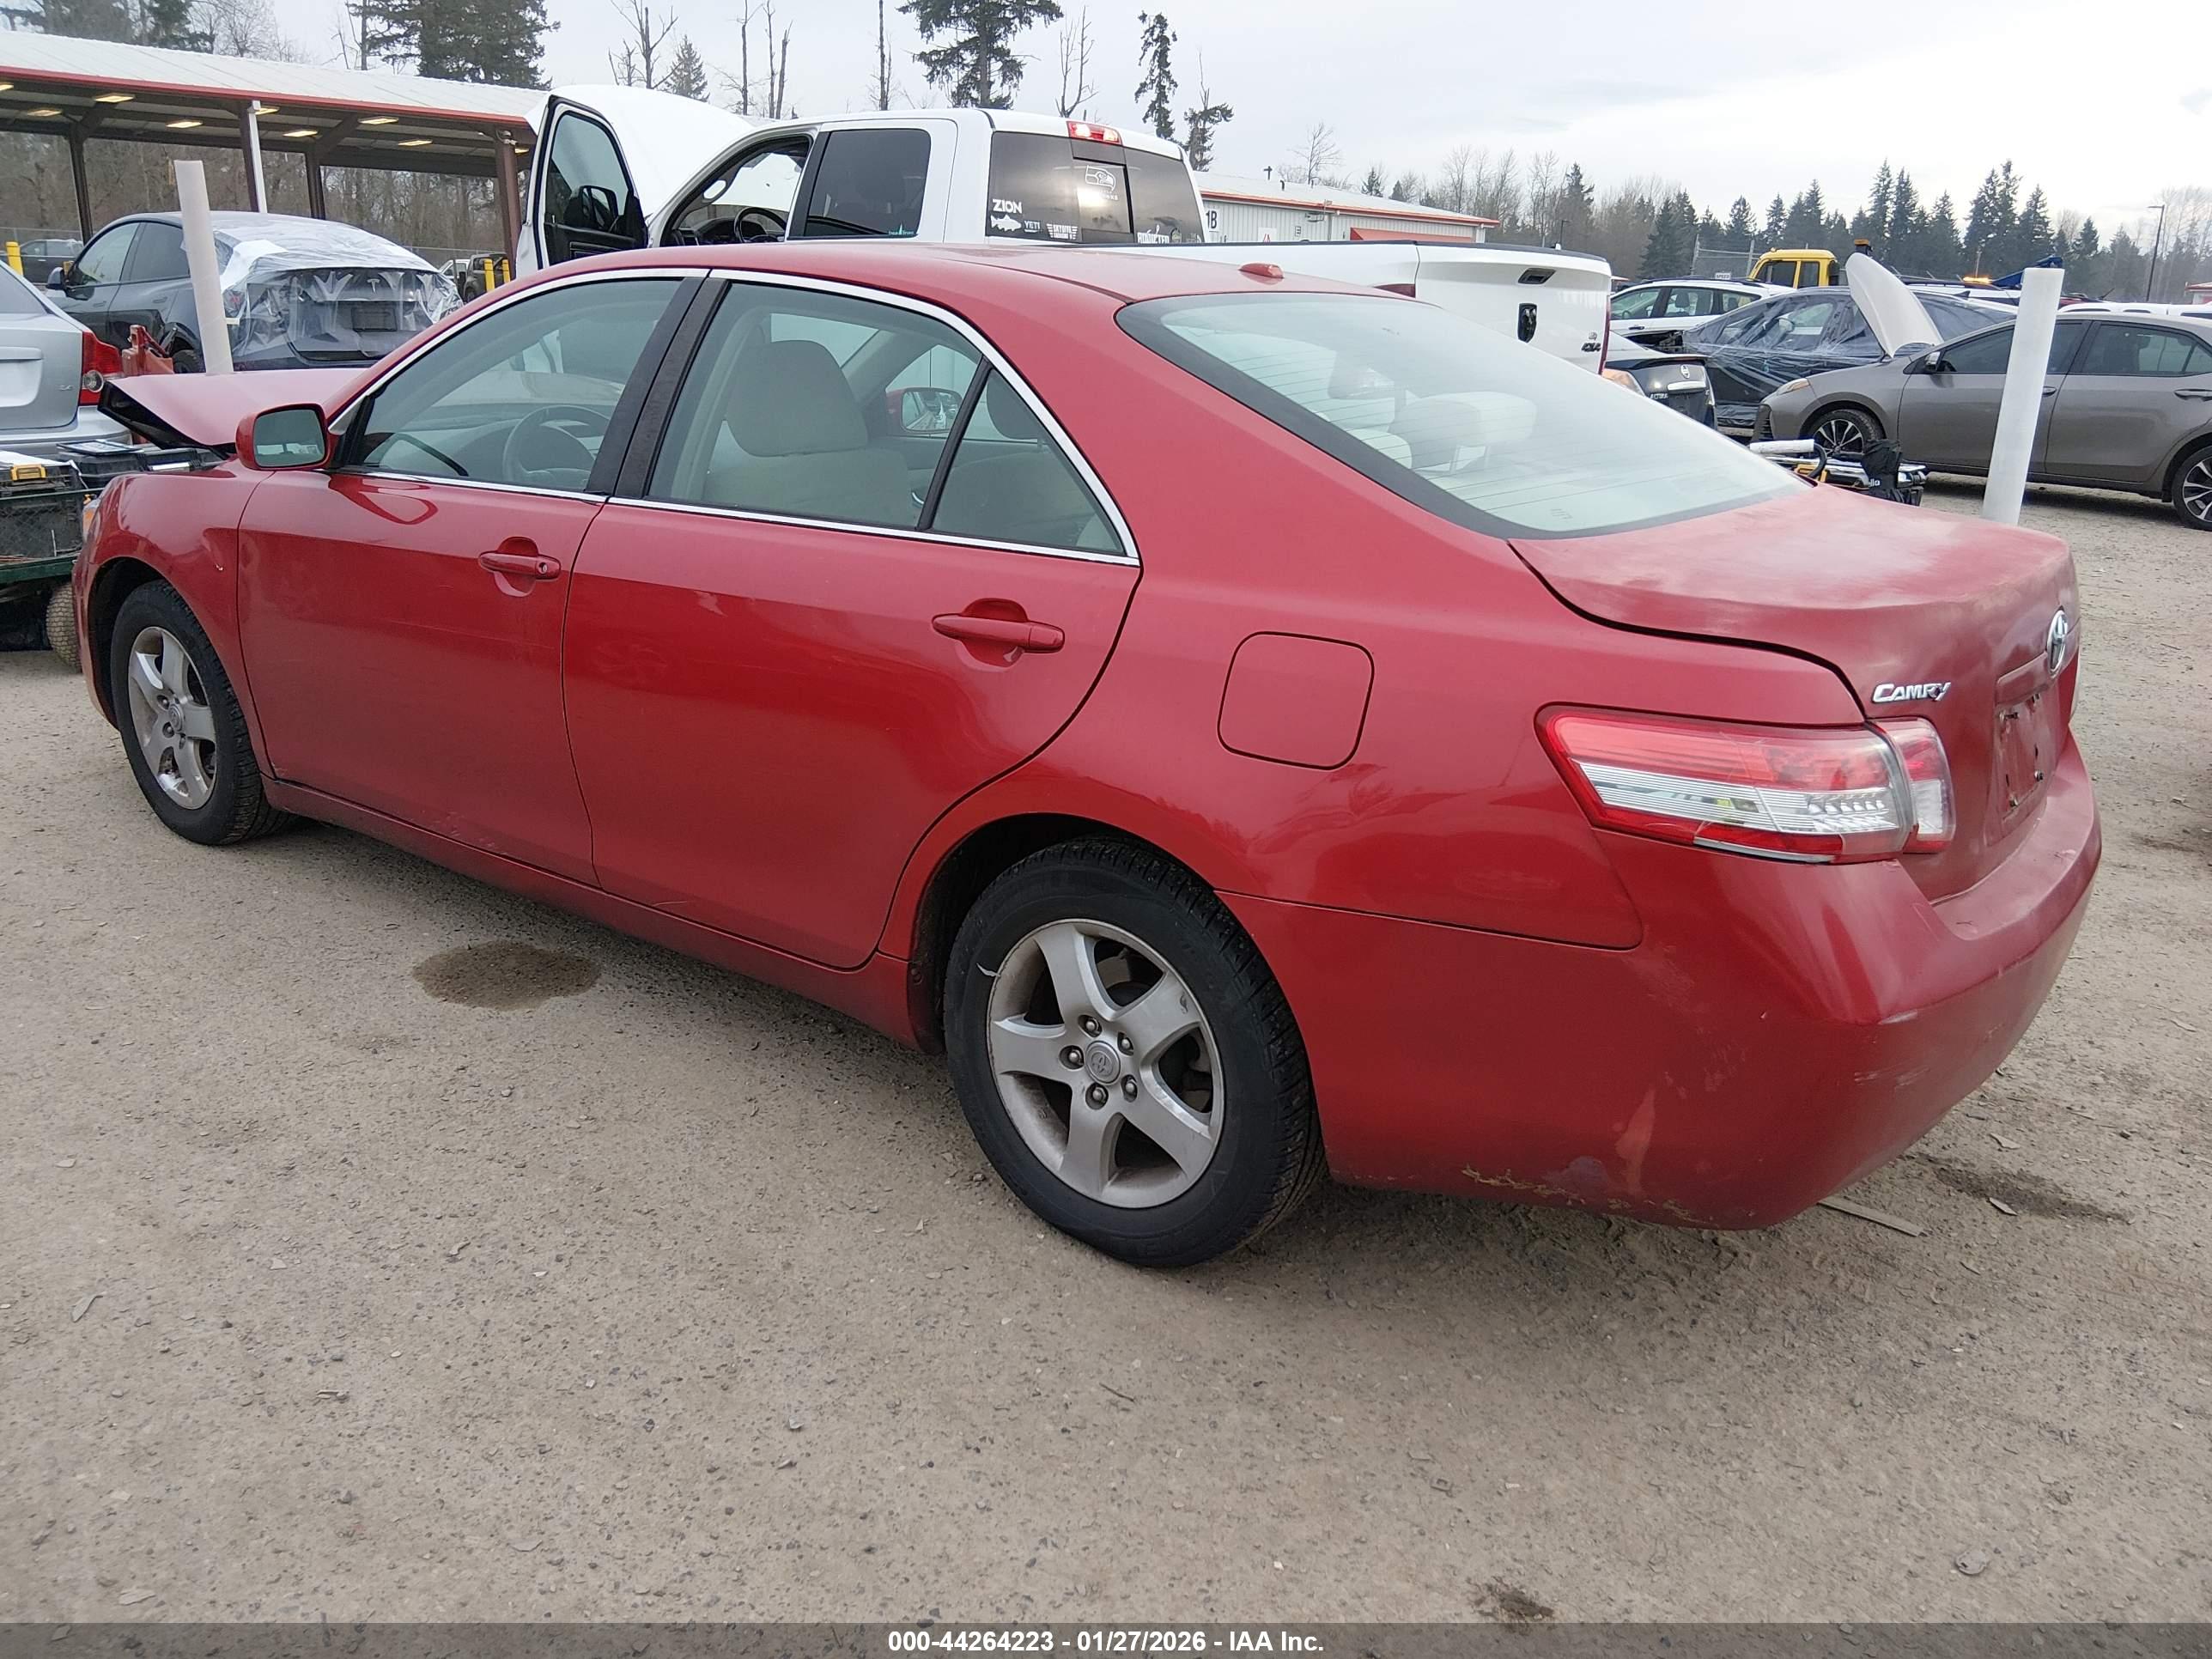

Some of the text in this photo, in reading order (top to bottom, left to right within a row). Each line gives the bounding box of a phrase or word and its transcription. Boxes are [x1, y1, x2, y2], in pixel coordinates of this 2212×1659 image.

[992, 198, 1023, 214] ZION
[1024, 221, 1041, 230] YETI
[1872, 681, 1952, 703] CAMRY
